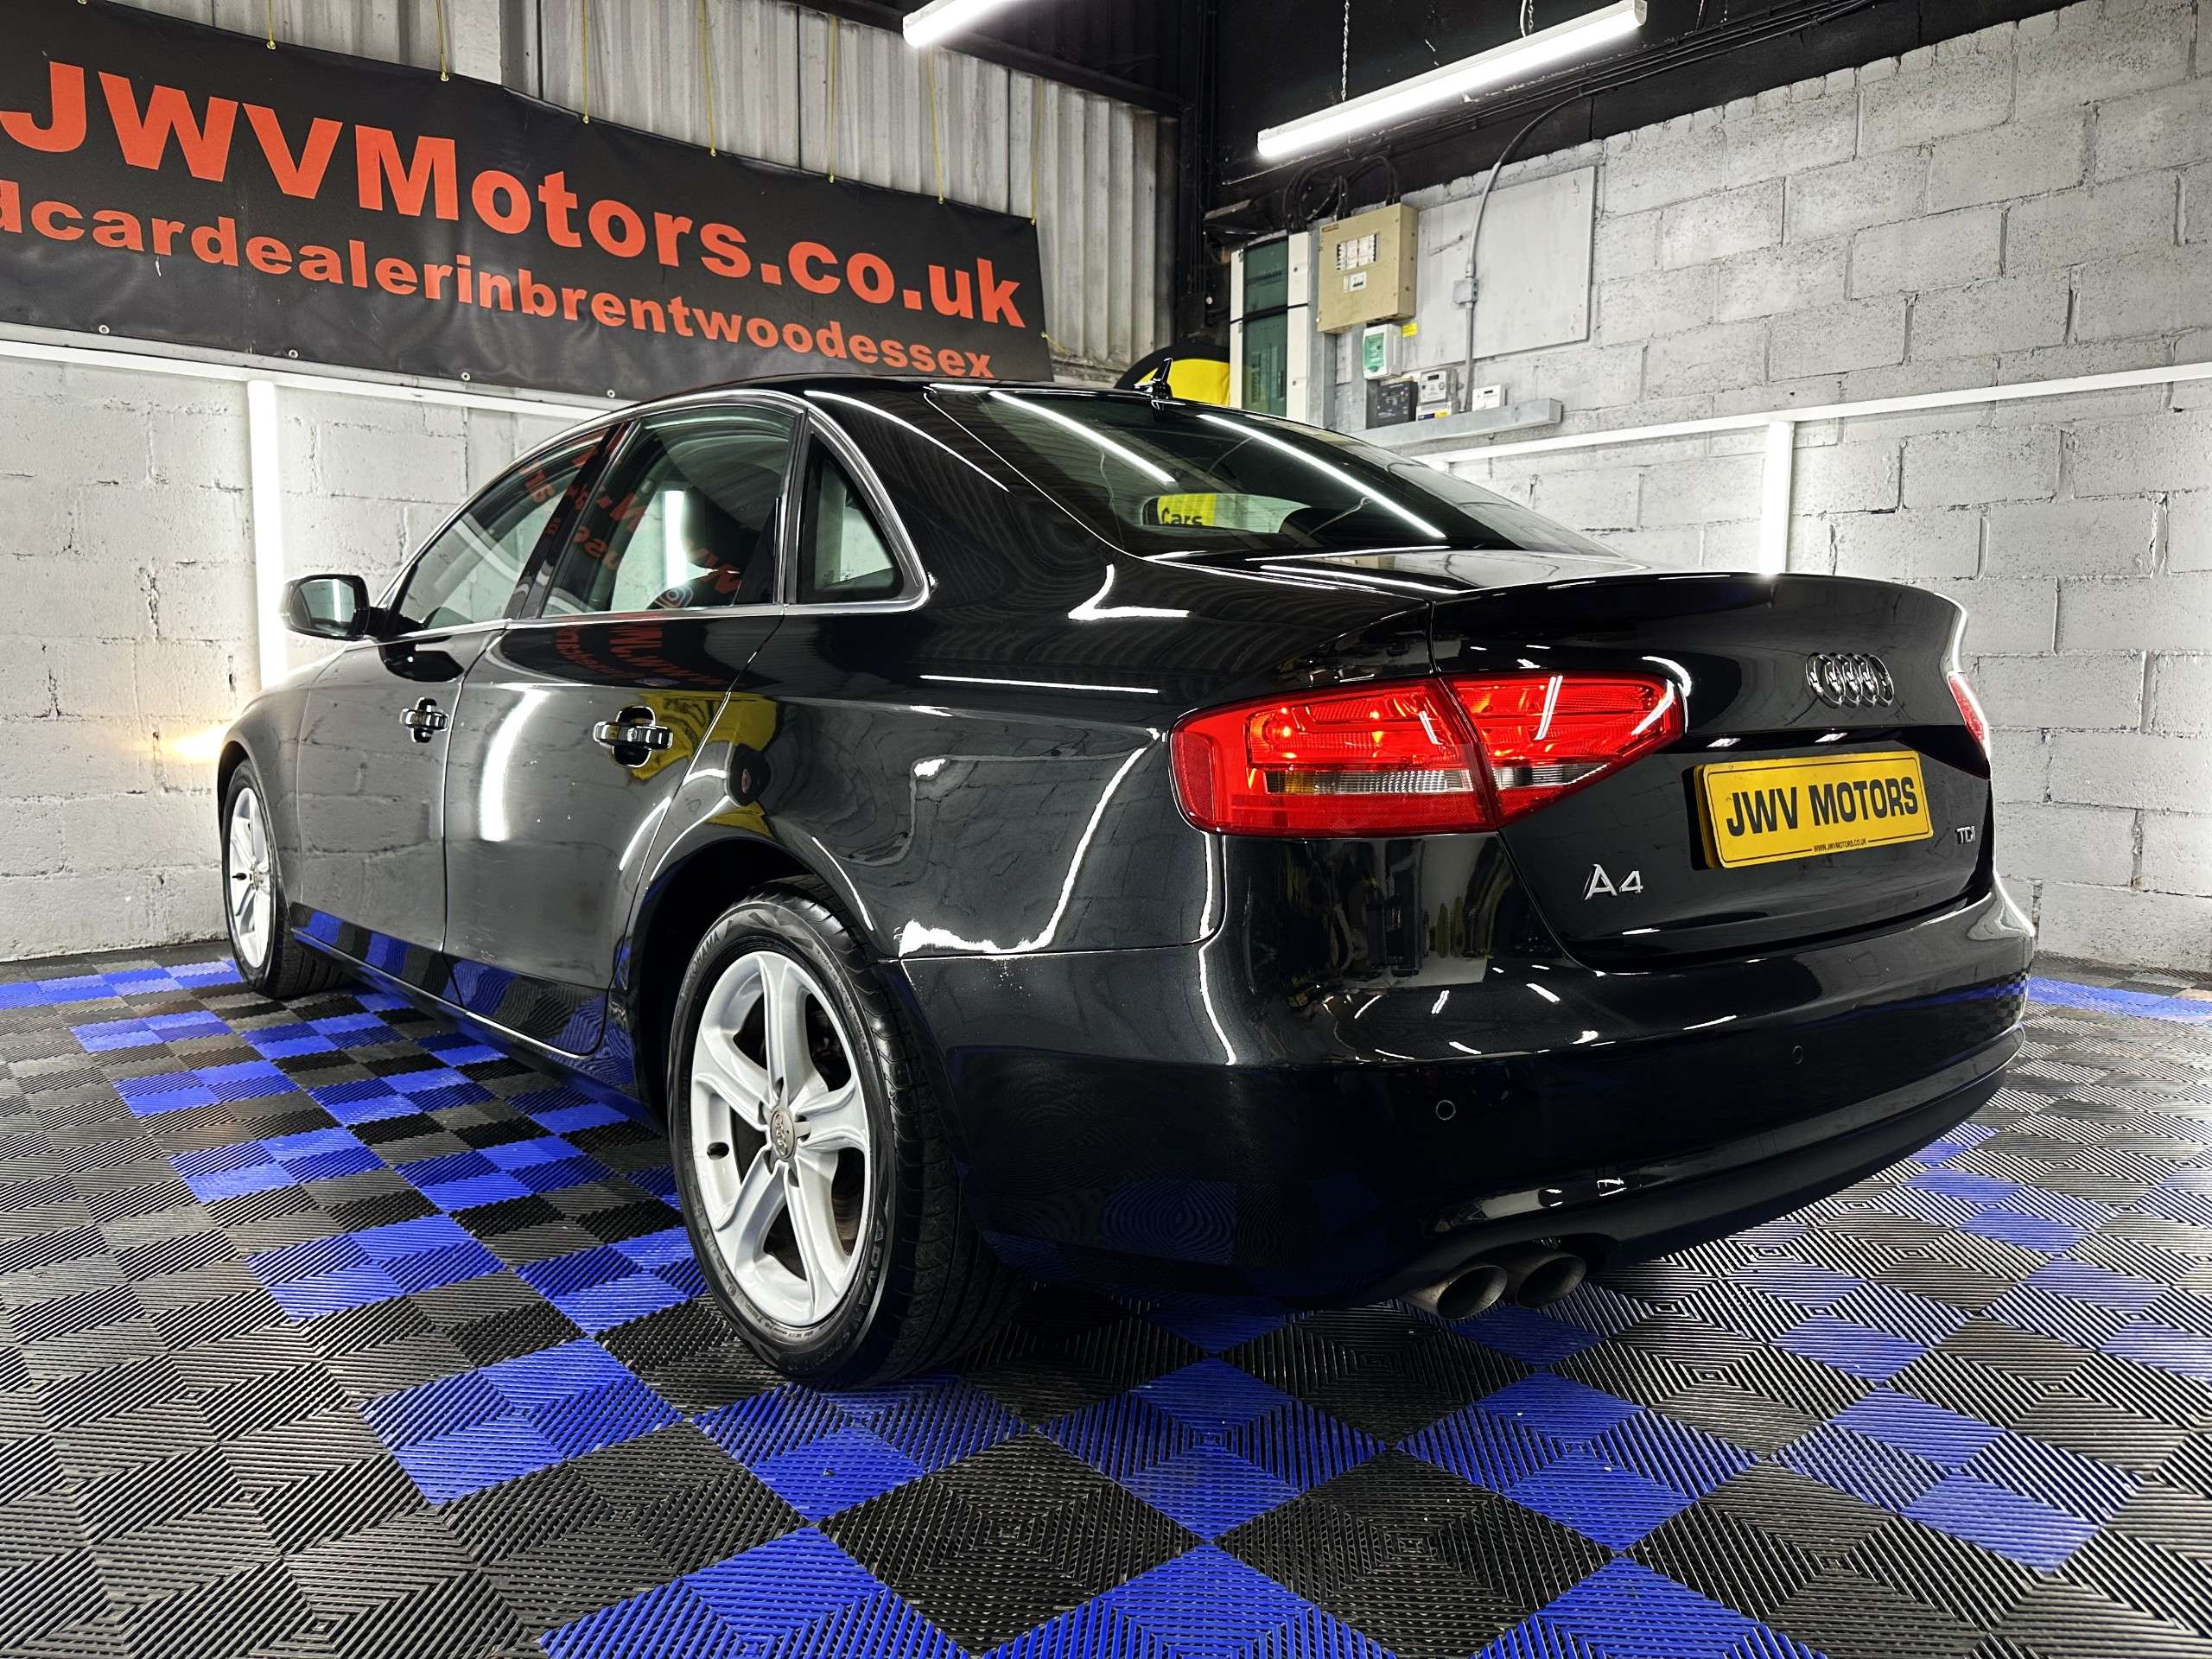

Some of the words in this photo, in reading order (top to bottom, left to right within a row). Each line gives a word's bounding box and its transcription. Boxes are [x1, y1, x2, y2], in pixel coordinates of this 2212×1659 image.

[0, 61, 1024, 327] JWVMotors.co.uk
[1161, 507, 1203, 526] Cars
[1726, 786, 1798, 837] JWV
[1808, 776, 1918, 826] MOTORS
[1955, 825, 1976, 844] TDI
[1583, 863, 1643, 900] A4
